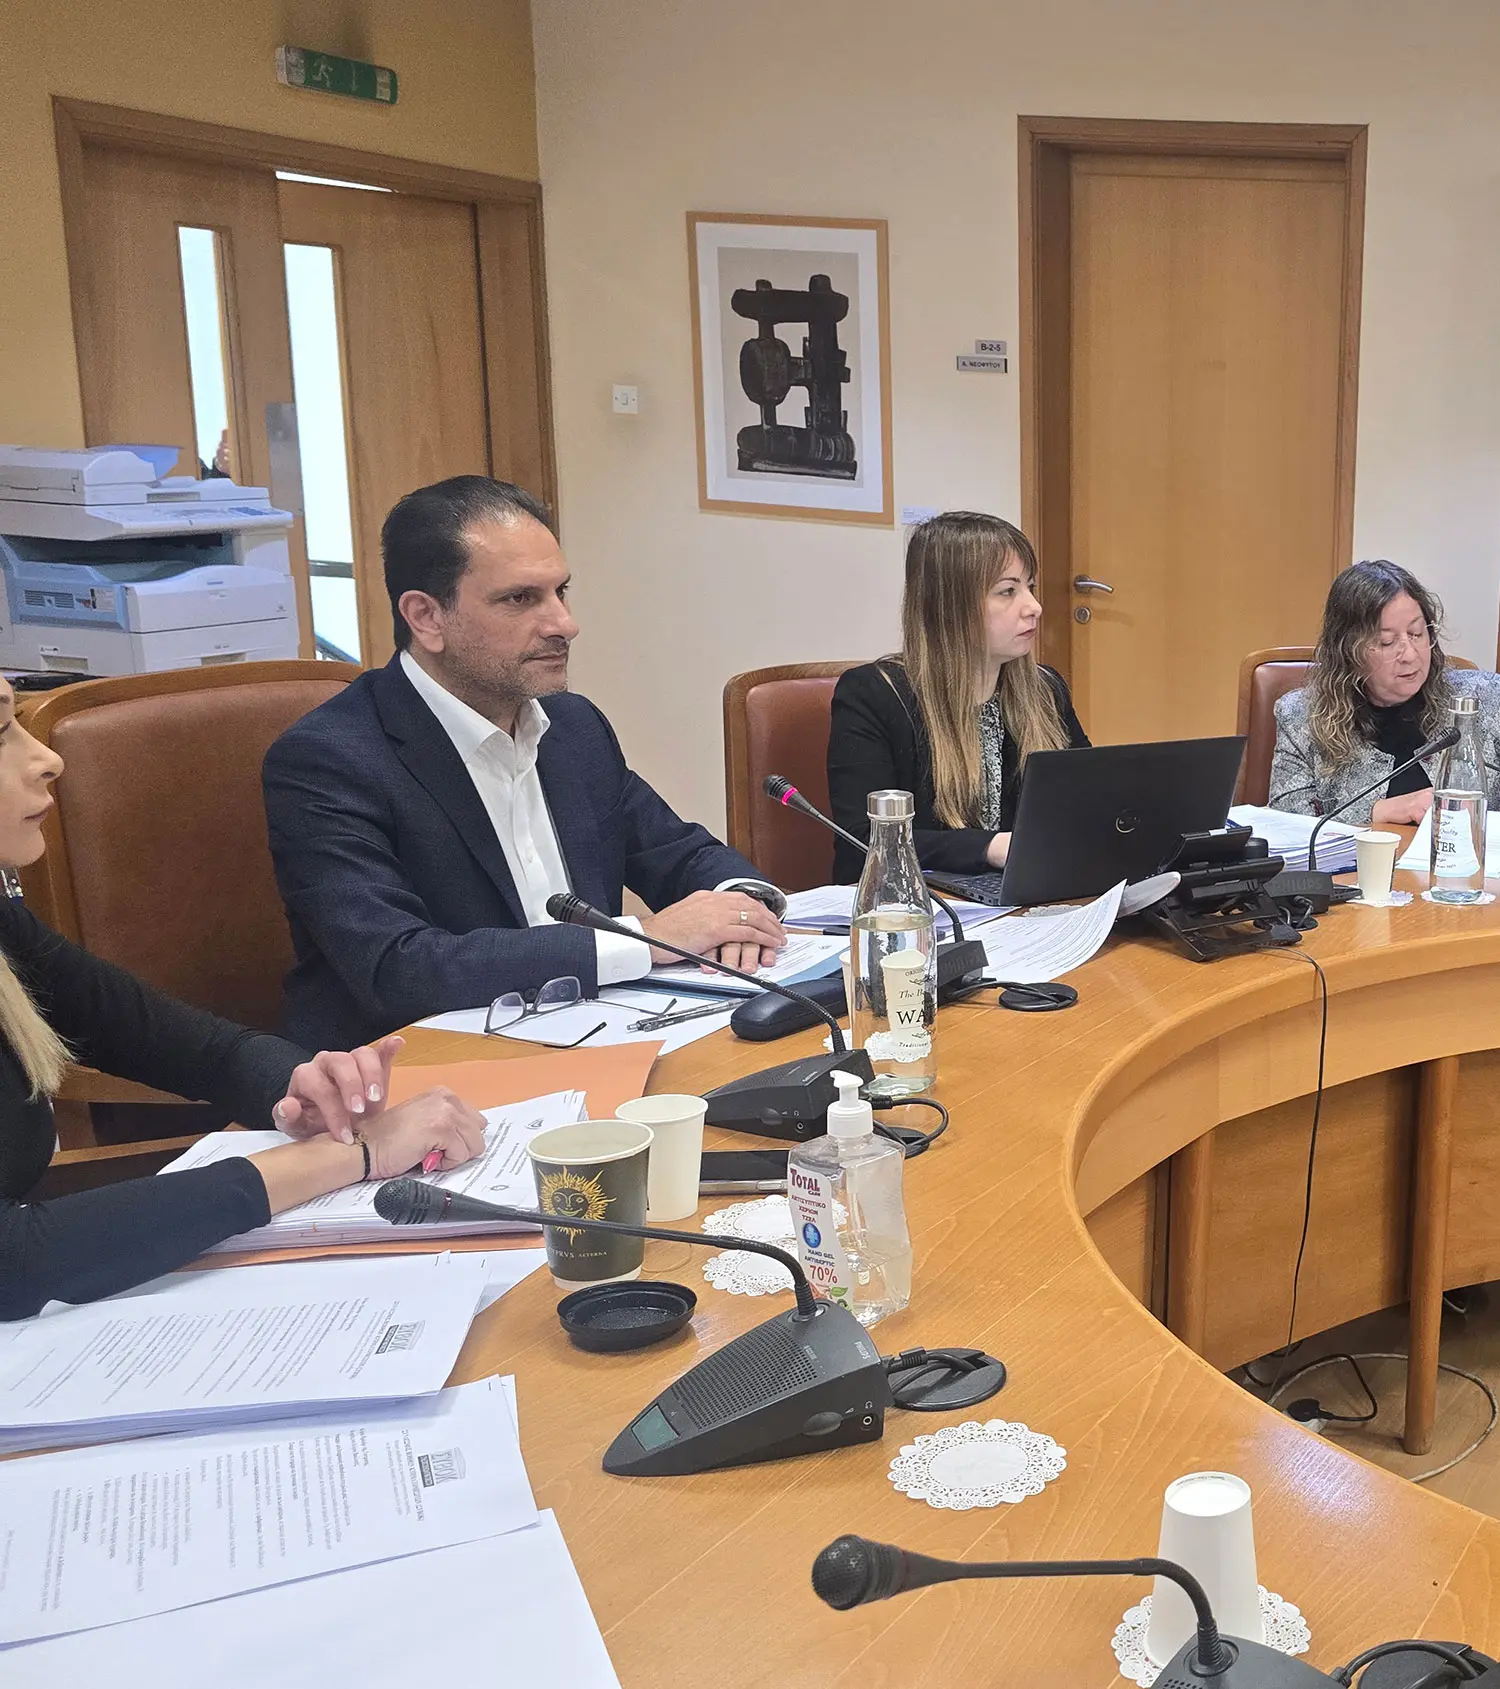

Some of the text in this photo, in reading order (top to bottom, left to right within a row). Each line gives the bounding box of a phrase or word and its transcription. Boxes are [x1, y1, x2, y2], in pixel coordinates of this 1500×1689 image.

[981, 343, 1001, 352] B-2-5
[789, 1168, 820, 1192] TOTAL
[809, 1265, 838, 1284] 70%
